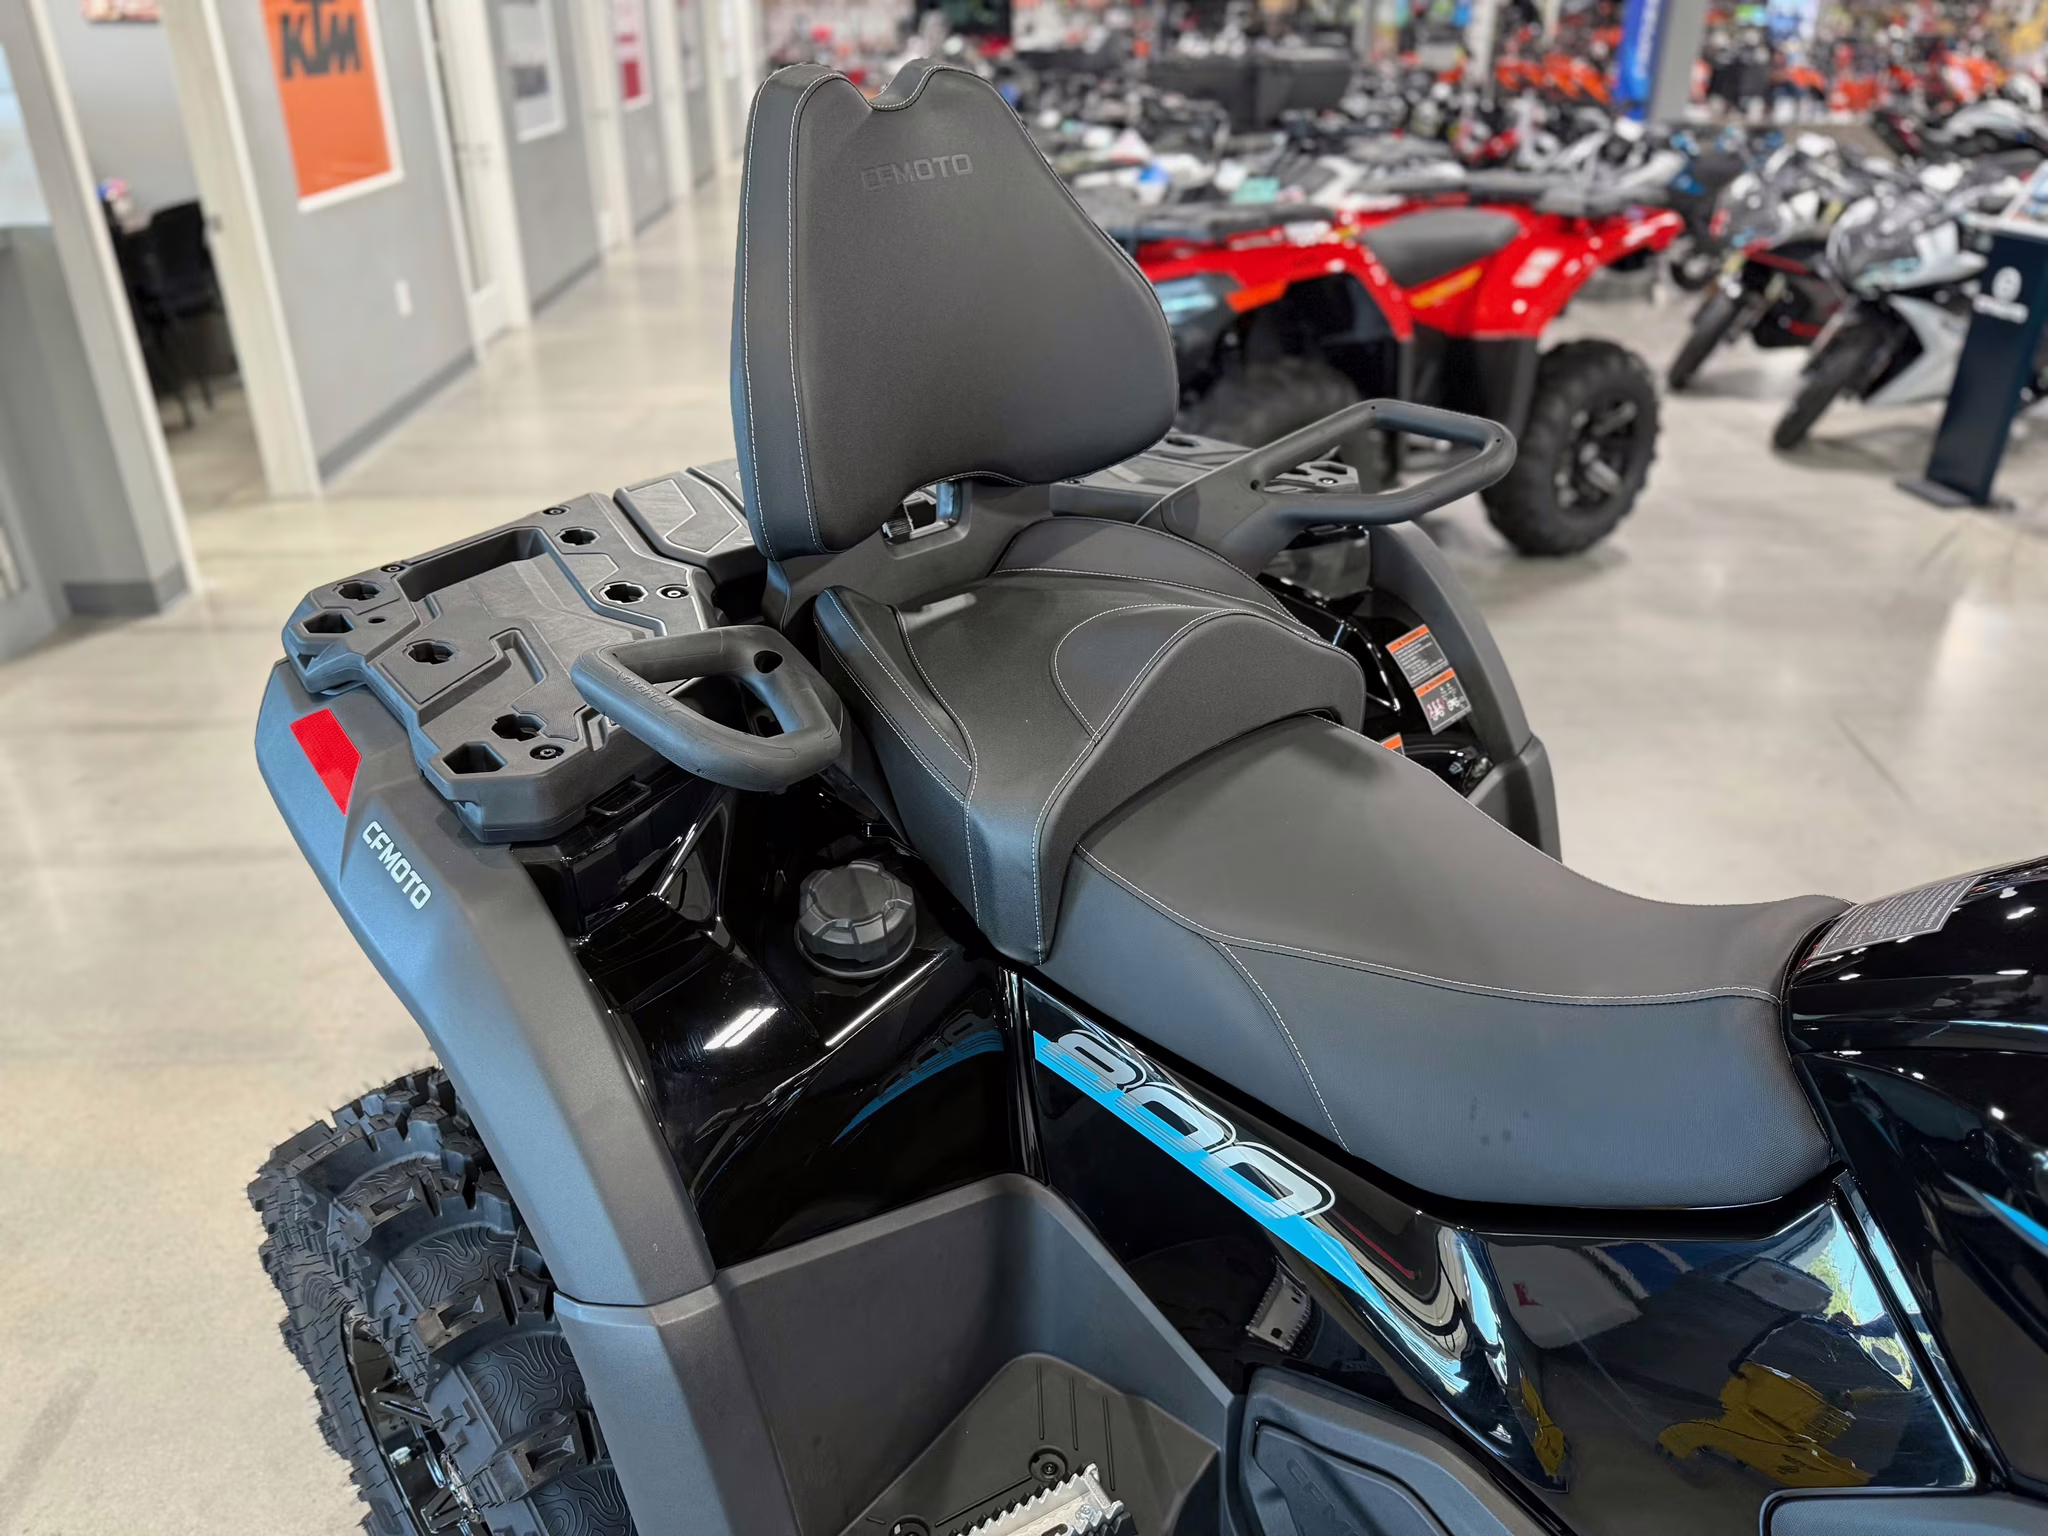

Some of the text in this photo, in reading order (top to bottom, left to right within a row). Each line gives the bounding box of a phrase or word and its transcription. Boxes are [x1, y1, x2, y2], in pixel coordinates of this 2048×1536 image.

[281, 0, 362, 79] KTM
[861, 153, 974, 191] CFMOTO
[362, 820, 432, 910] CFMOTO
[1040, 1029, 1336, 1220] 800
